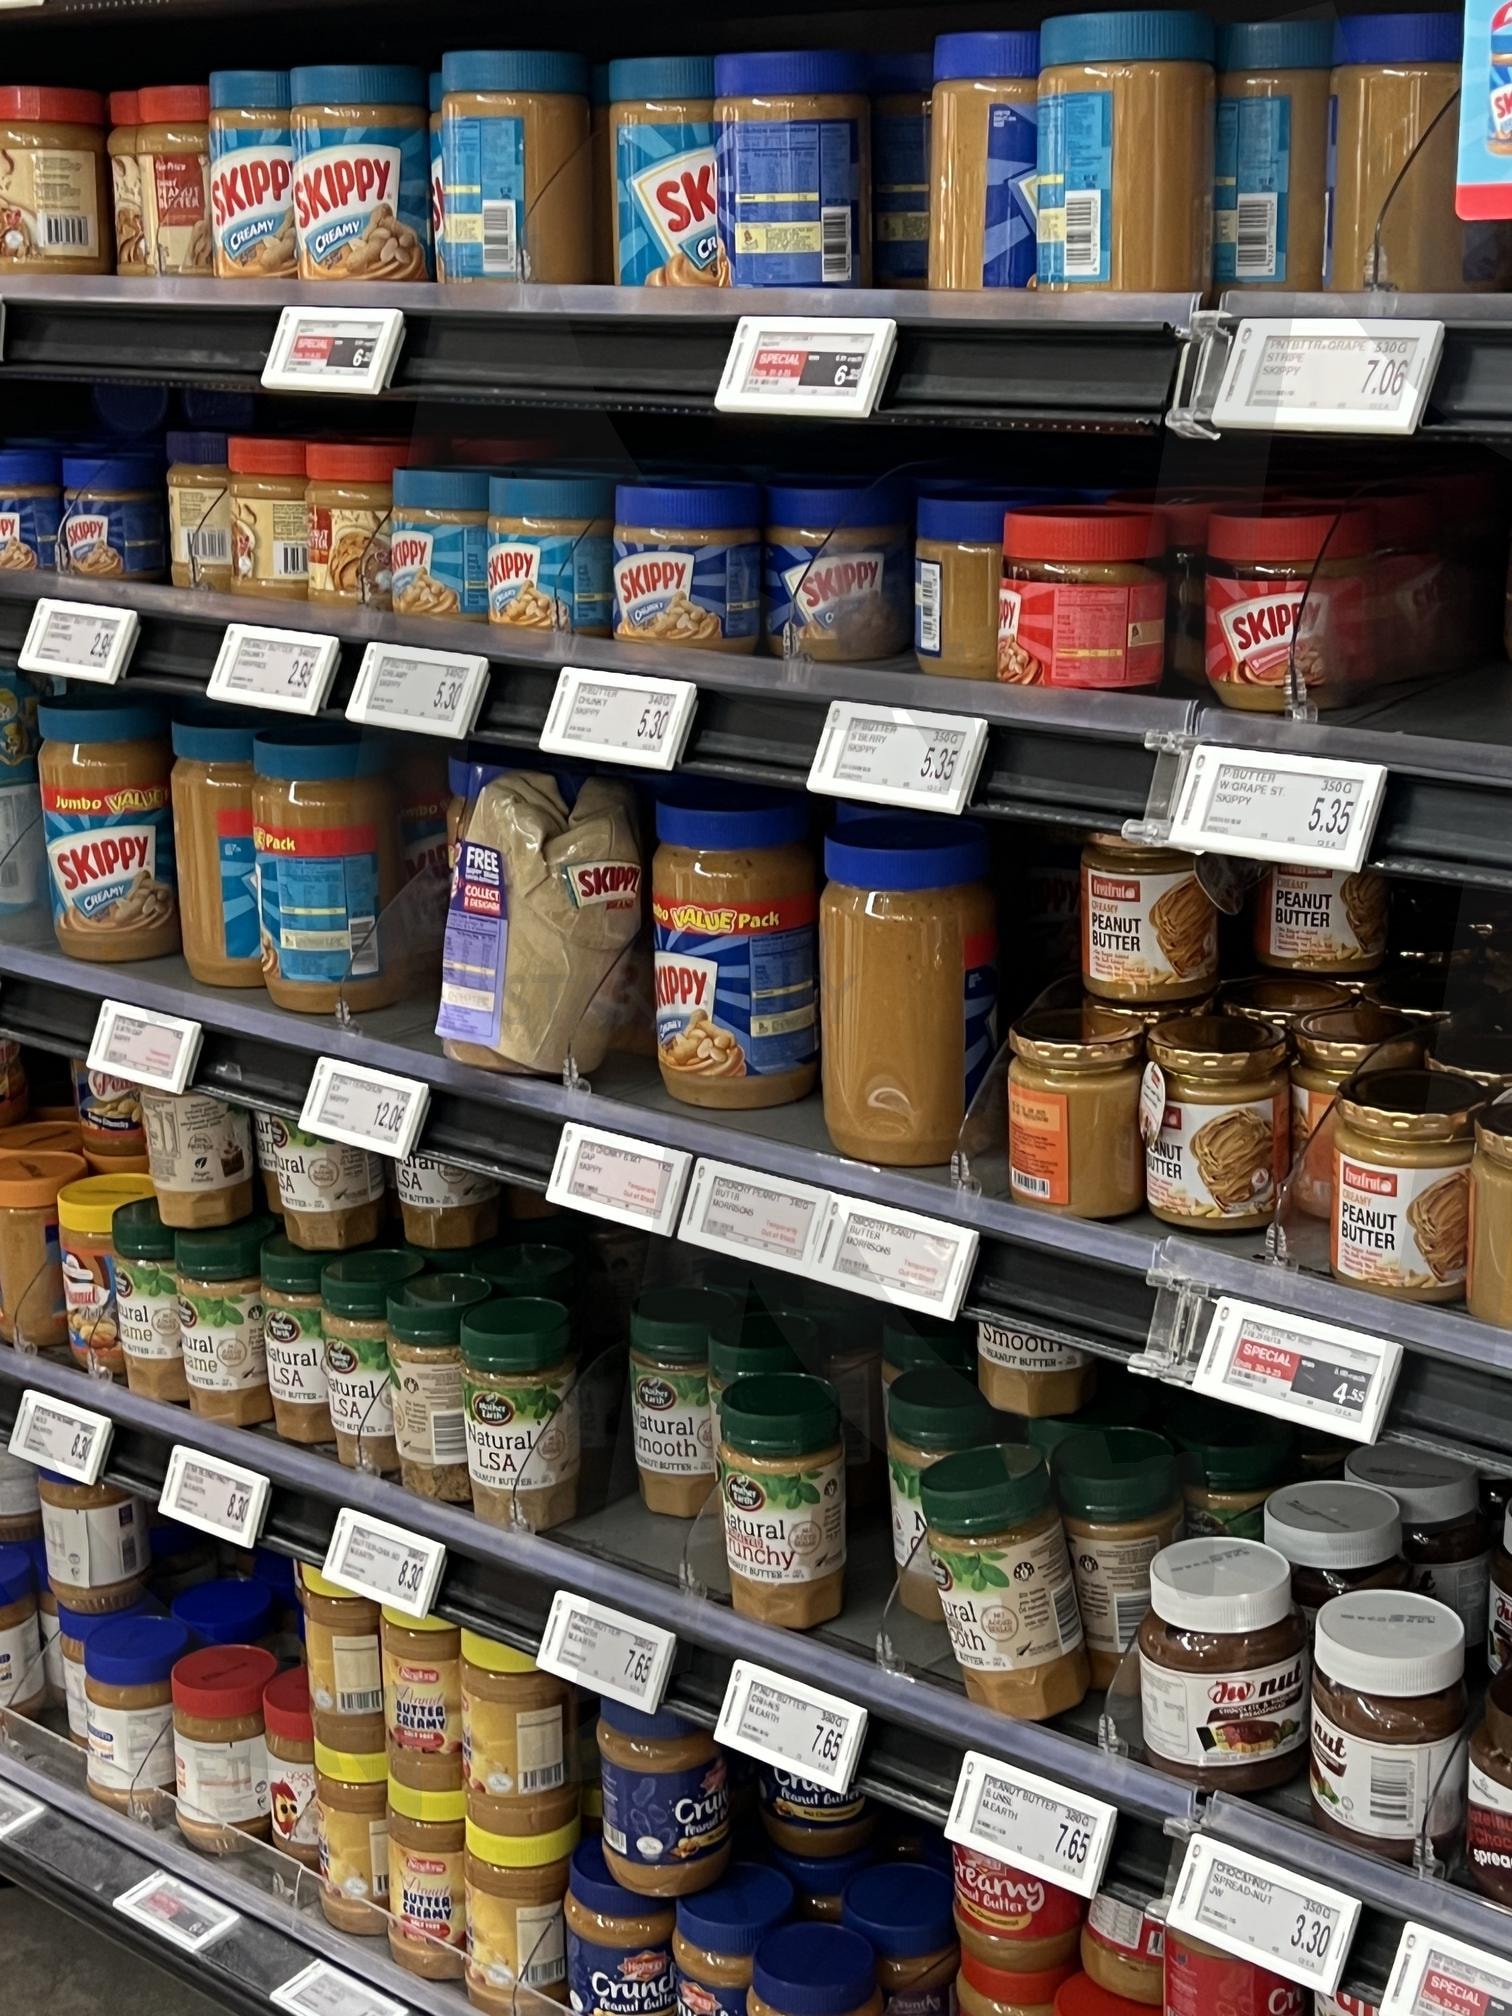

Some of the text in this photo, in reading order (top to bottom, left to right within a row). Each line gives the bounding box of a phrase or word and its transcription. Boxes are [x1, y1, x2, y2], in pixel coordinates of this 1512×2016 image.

[212, 159, 293, 227] SKIPP
[295, 158, 391, 228] SKIPPY
[230, 219, 275, 250] CREAMY
[315, 219, 360, 252] CREAMY
[758, 352, 800, 366] SPECIAL
[1361, 359, 1409, 396] 7.06
[67, 520, 104, 548] SKIPPY
[393, 540, 428, 571] KIPPY
[487, 552, 534, 591] SKIPPY
[620, 561, 687, 603] SKIPPY
[801, 560, 879, 606] SKIPPY
[433, 681, 463, 711] 5.30
[636, 709, 669, 740] 5.30
[920, 747, 959, 781] 5.35
[1321, 779, 1353, 795] 350G
[56, 796, 102, 811] Jumbo
[1307, 797, 1355, 835] 5.35
[265, 834, 296, 852] Pack
[57, 836, 150, 892] SKIPPY
[466, 846, 499, 873] FREE
[84, 885, 125, 911] CREAMY
[464, 884, 500, 902] COLLECT
[1275, 889, 1333, 911] PEANUT
[673, 905, 737, 934] VALUE
[738, 911, 780, 929] Pack
[1091, 912, 1142, 935] PEANUT
[1274, 907, 1331, 928] BUTTER
[1091, 930, 1141, 952] BUTTER
[655, 966, 708, 1009] KIPPY
[1148, 1155, 1183, 1180] UTTER
[765, 1219, 798, 1235] Temporarily
[1341, 1200, 1398, 1231] PEANUT
[845, 1236, 892, 1256] MORRISONS
[849, 1225, 882, 1241] BUTTER
[1340, 1221, 1396, 1251] BUTTER
[1019, 1358, 1057, 1368] BUTTER
[1242, 1342, 1292, 1368] SPECIAL
[273, 1363, 305, 1388] LSA
[331, 1394, 362, 1420] LSA
[70, 1432, 92, 1461] 8.30
[467, 1421, 535, 1450] Natural
[638, 1435, 698, 1457] mooth
[478, 1449, 518, 1473] LSA
[659, 1461, 692, 1472] BUTTER
[226, 1493, 250, 1523] 8.30
[729, 1537, 796, 1571] runchy
[397, 1560, 424, 1592] 8.30
[749, 1564, 783, 1579] BUTTER
[623, 1648, 653, 1683] 7.65
[1258, 1660, 1302, 1698] nut
[396, 1699, 445, 1717] BUTTER
[396, 1712, 446, 1730] CREAMY
[811, 1723, 843, 1761] 7.65
[1314, 1719, 1347, 1759] nut
[987, 1776, 1058, 1812] PEANUT BUTTER
[1055, 1823, 1091, 1864] 7.65
[403, 1889, 451, 1908] BUTTER
[957, 1857, 1046, 1913] reamy
[1212, 1874, 1273, 1905] SPREAD-NUT
[402, 1901, 452, 1921] CREAMY
[982, 1894, 1024, 1913] Butter
[1303, 1899, 1332, 1920] 350G
[1290, 1913, 1332, 1958] 3.30
[599, 1997, 640, 2013] Peanut
[1430, 1974, 1482, 2007] SPECIAL
